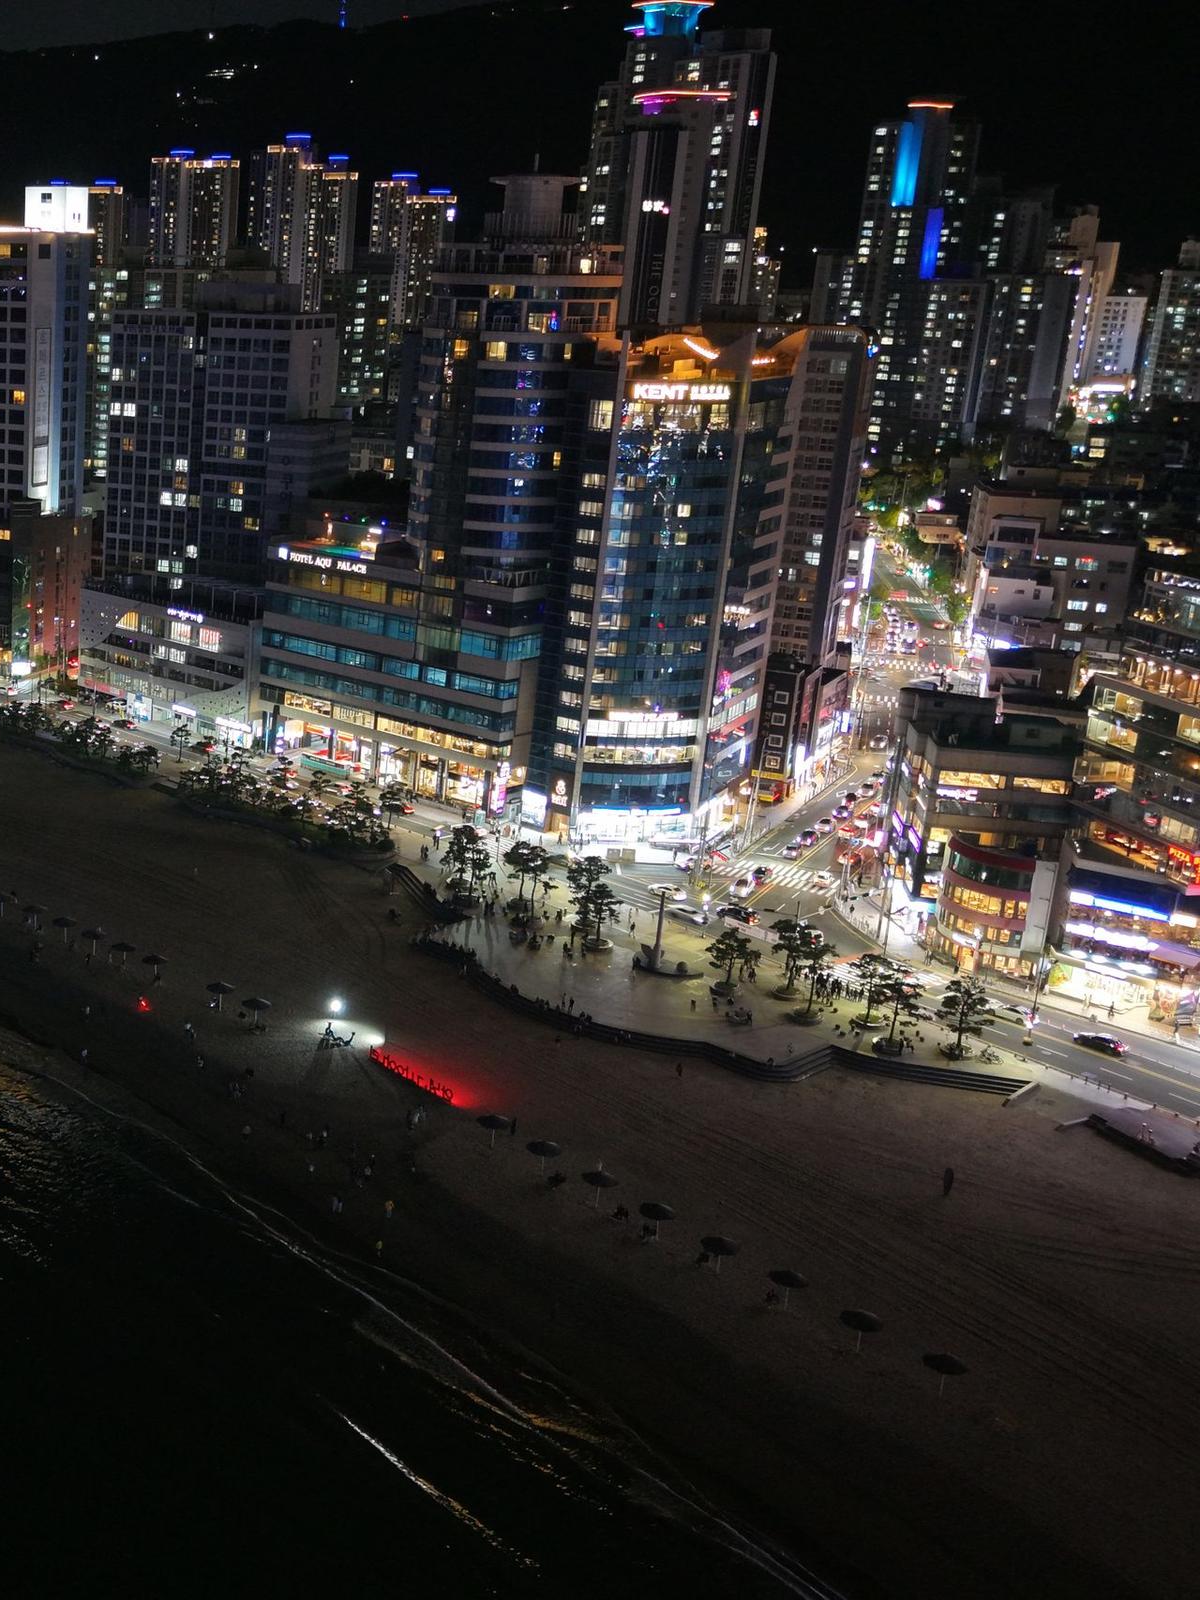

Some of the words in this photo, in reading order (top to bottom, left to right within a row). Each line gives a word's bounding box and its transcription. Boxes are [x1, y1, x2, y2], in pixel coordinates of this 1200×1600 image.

[634, 383, 689, 400] KENT
[289, 552, 314, 565] HOTEL
[314, 557, 333, 569] AQU
[336, 560, 367, 574] PALACE
[1169, 846, 1190, 862] PIZZA
